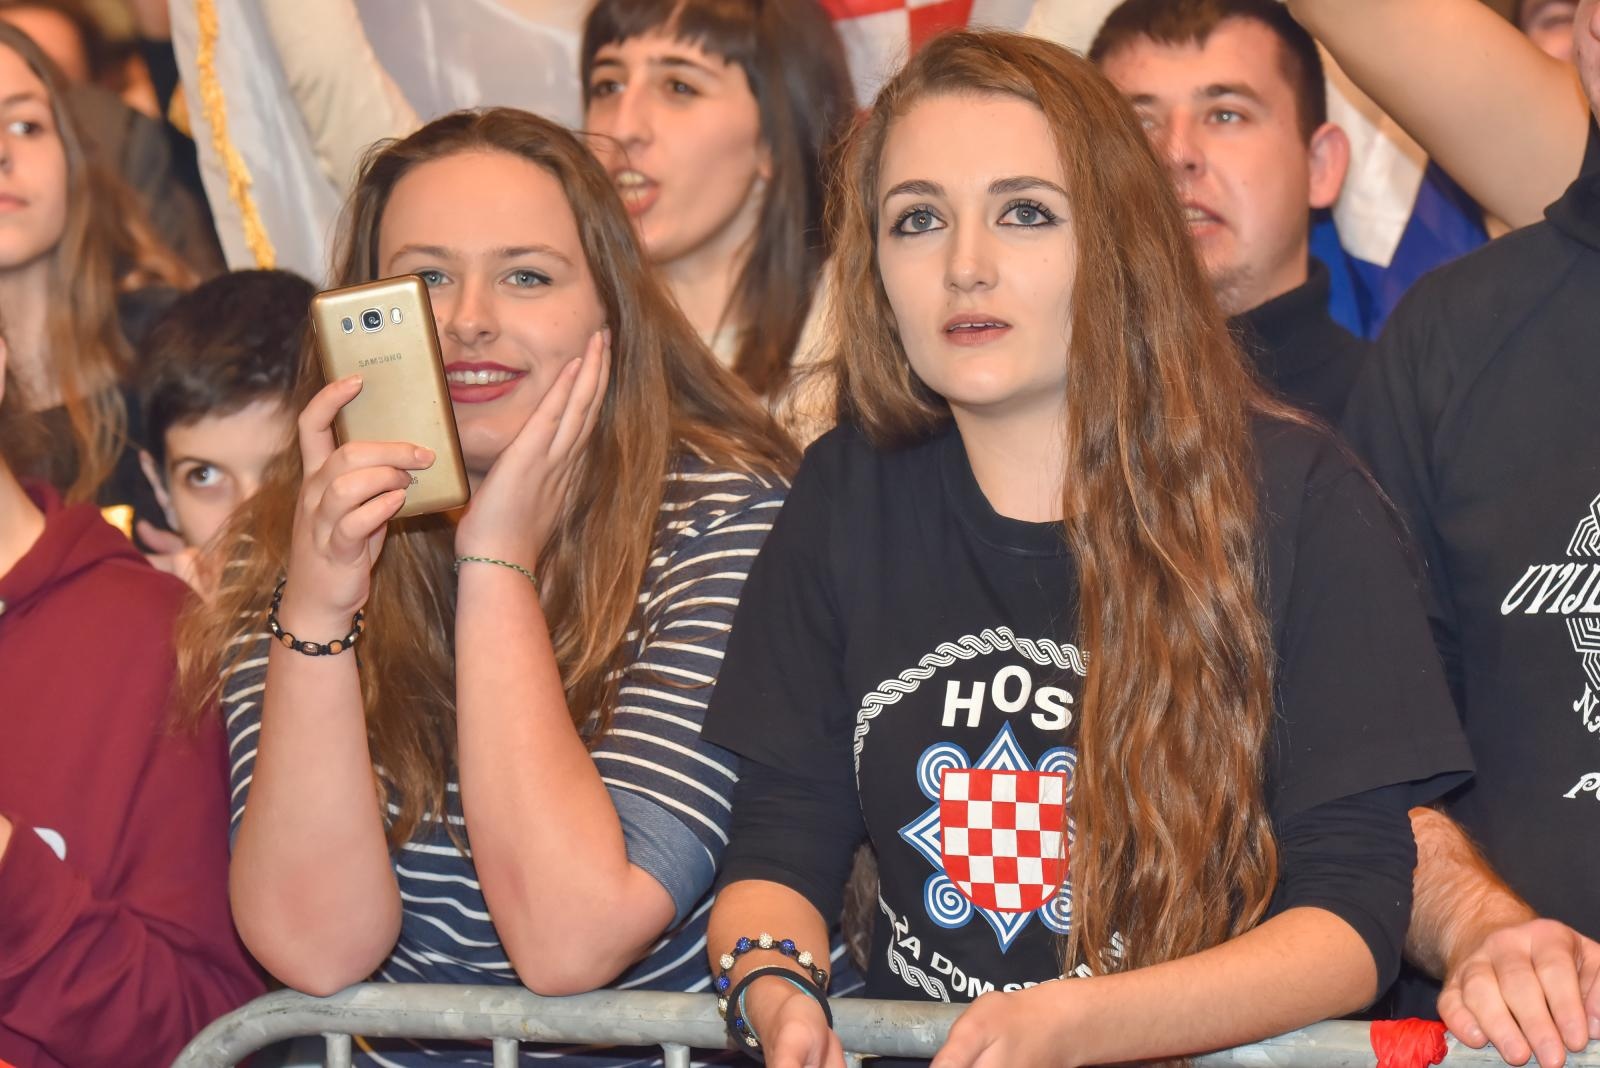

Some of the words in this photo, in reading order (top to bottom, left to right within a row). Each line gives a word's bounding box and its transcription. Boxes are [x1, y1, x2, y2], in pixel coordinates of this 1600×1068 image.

[358, 352, 402, 368] SAMSUNG
[941, 665, 1073, 730] HOS
[895, 915, 920, 960] ZA
[930, 952, 994, 998] DOM
